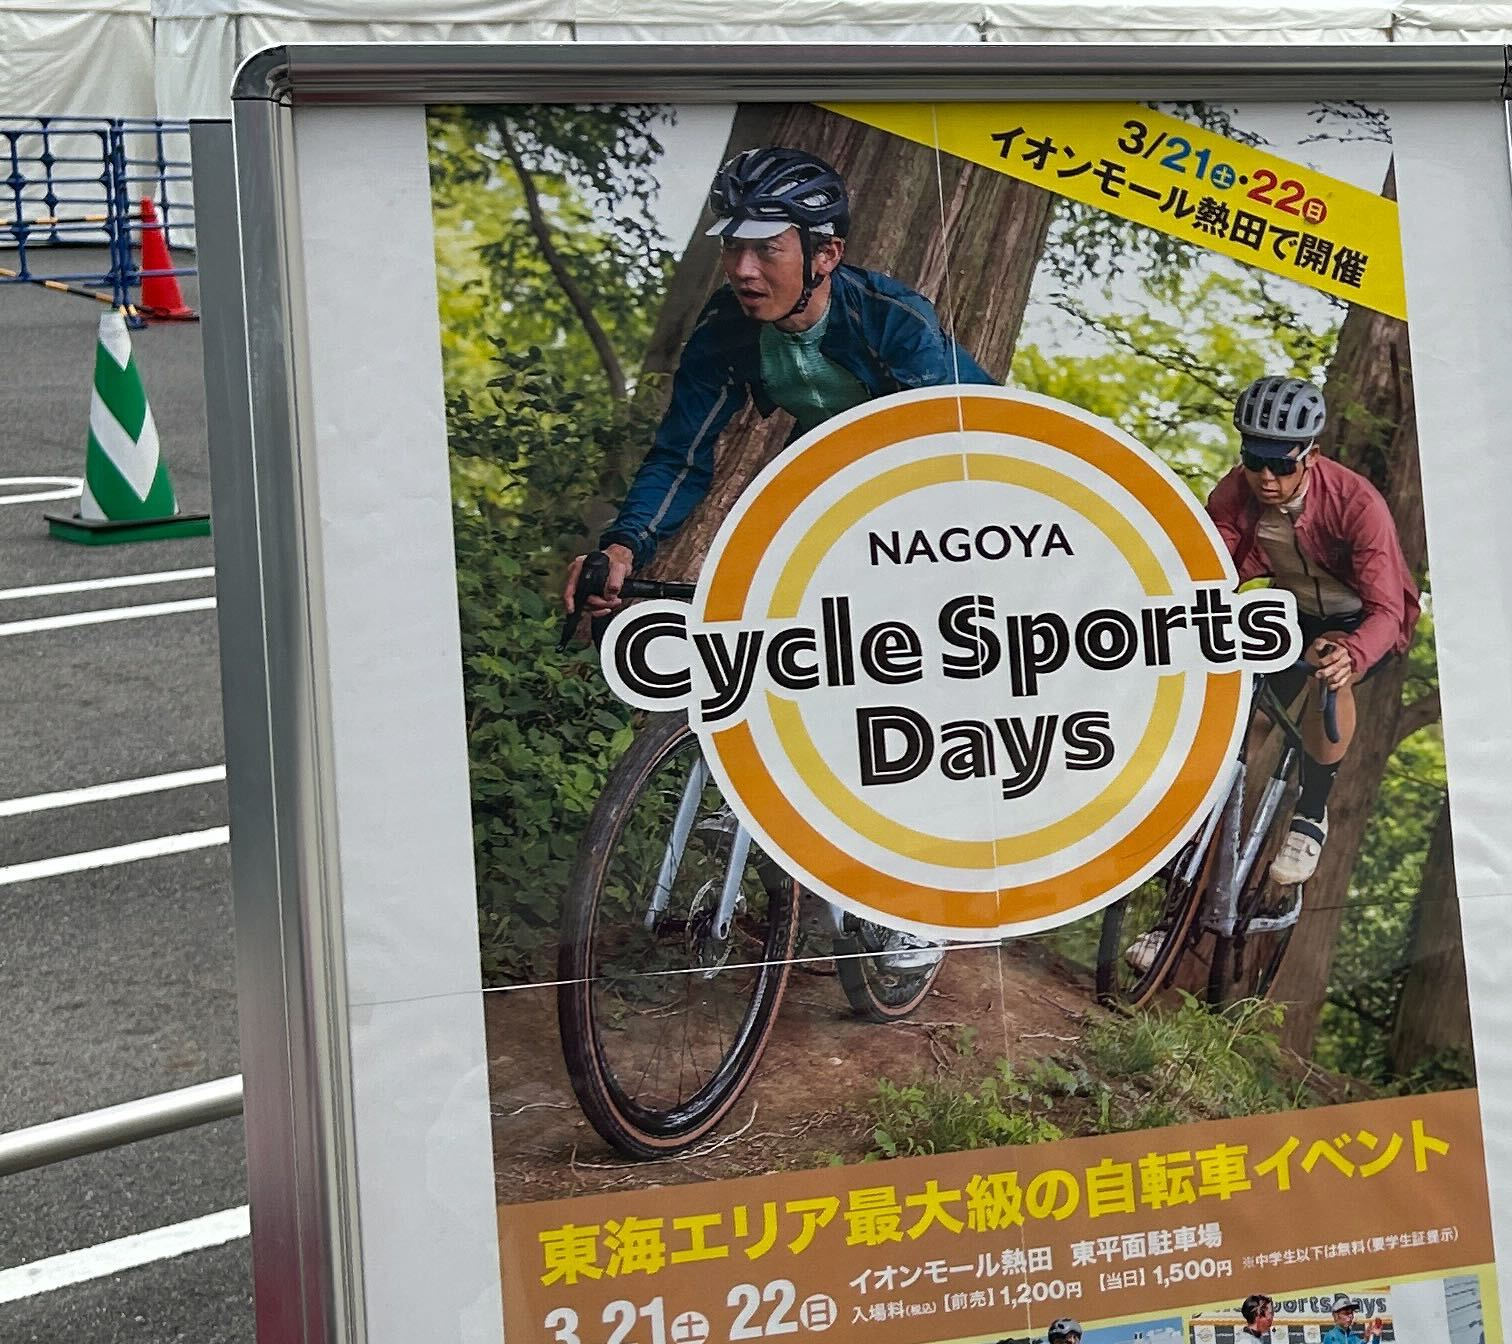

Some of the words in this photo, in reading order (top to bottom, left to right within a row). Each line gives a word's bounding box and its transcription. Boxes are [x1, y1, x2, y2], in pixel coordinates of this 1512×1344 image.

[990, 126, 1369, 288] イオンモール熱田で開催
[869, 523, 1074, 566] NAGOYA
[608, 596, 923, 723] Cycle
[937, 588, 1292, 697] Sports
[856, 705, 1116, 800] Days
[538, 1119, 1450, 1286] 東海エリア最大級の自転車イベント
[849, 1246, 1053, 1295] イオンモール熱田
[1070, 1222, 1223, 1267] 東平面駐車場
